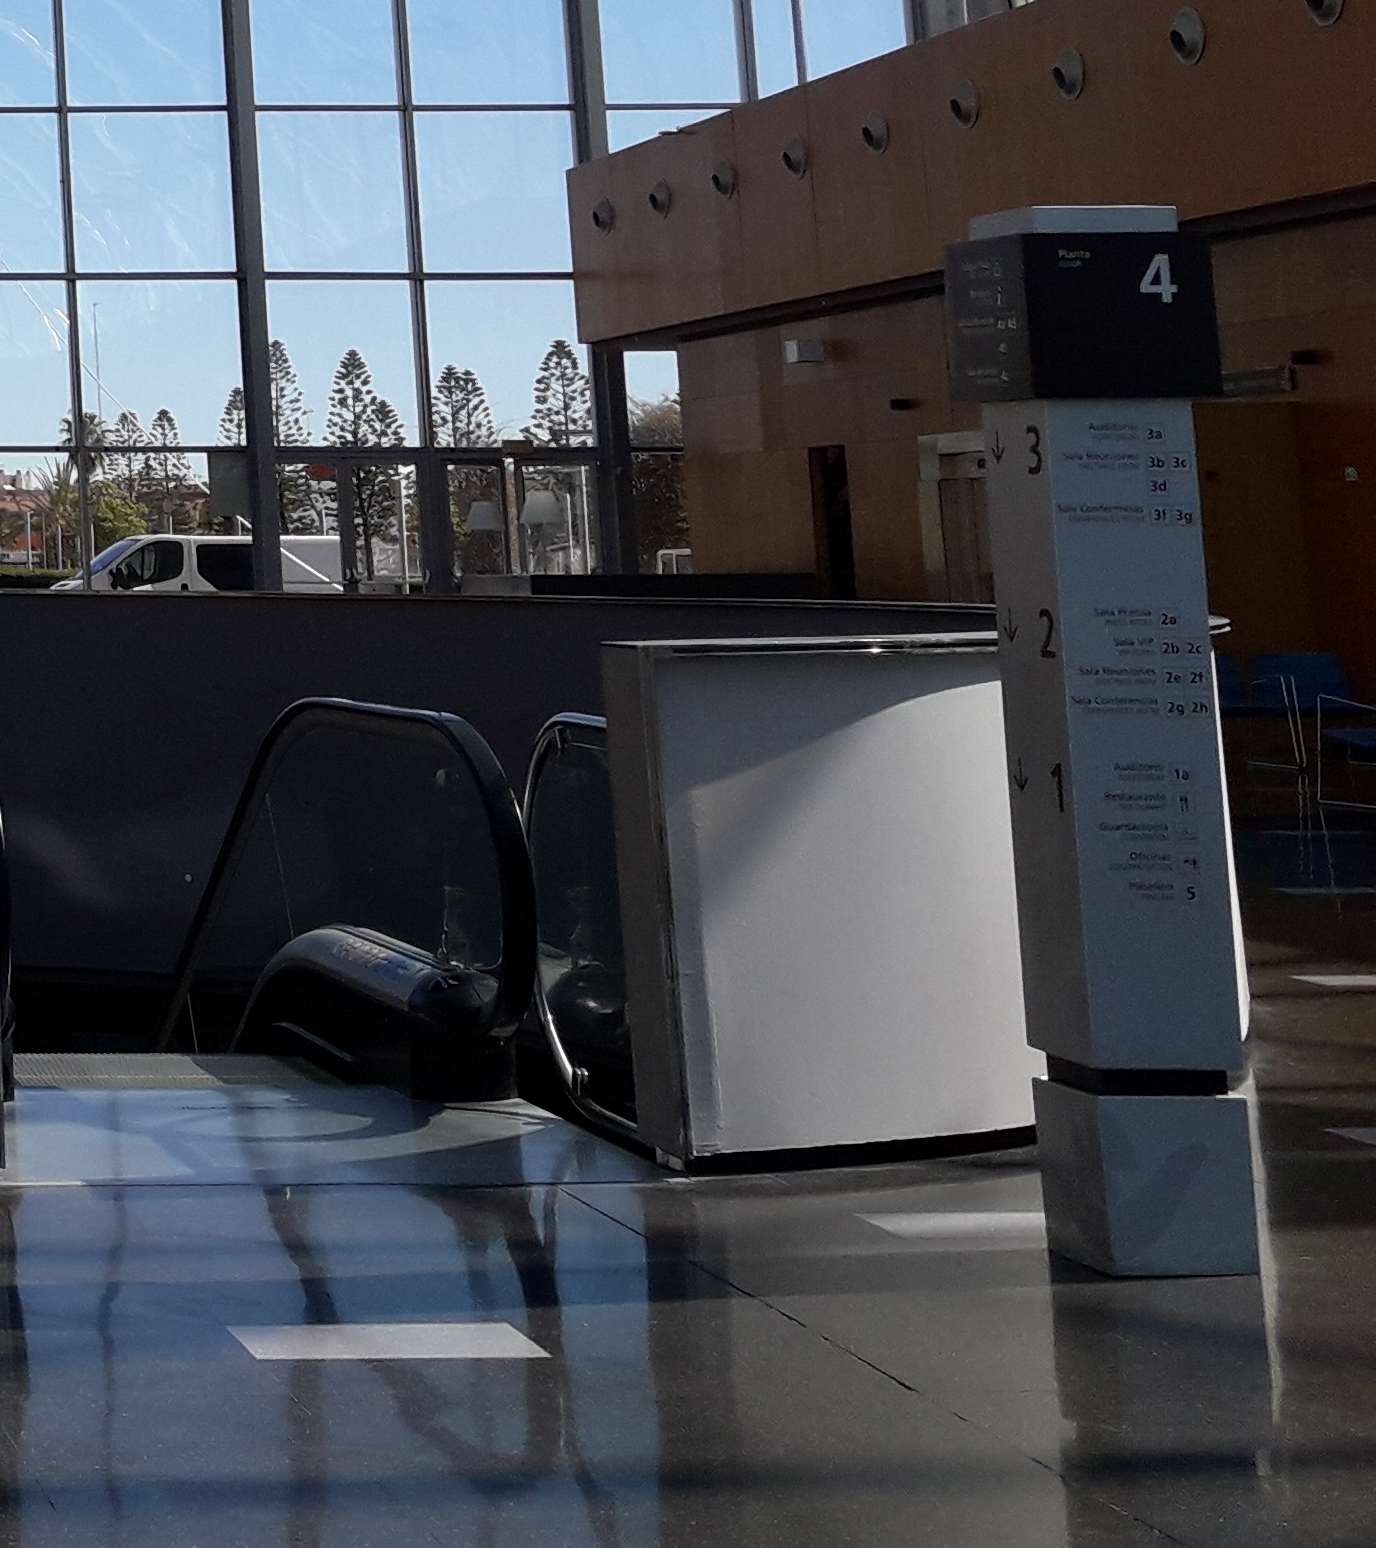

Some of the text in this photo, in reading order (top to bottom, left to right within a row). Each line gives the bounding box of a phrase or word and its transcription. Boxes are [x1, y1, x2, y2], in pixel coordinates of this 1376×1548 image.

[1057, 249, 1091, 259] Planta
[1139, 252, 1180, 304] 4
[1147, 428, 1163, 440] 3a
[1025, 425, 1043, 475] 3
[1148, 456, 1166, 468] 3b
[1172, 456, 1188, 468] 3c
[1150, 480, 1167, 492] 3d
[1153, 508, 1167, 521] 3f
[1175, 509, 1193, 525] 3g
[1160, 613, 1177, 626] 2a
[1038, 608, 1056, 659] 2
[1163, 642, 1180, 654] 2b
[1187, 642, 1202, 654] 2c
[1166, 671, 1182, 684] 2e
[1189, 671, 1204, 684] 2f
[1167, 701, 1185, 716] 2g
[1191, 701, 1209, 713] 2h
[1175, 769, 1190, 781] 1a
[1049, 762, 1064, 813] 1
[1186, 885, 1196, 901] 5
